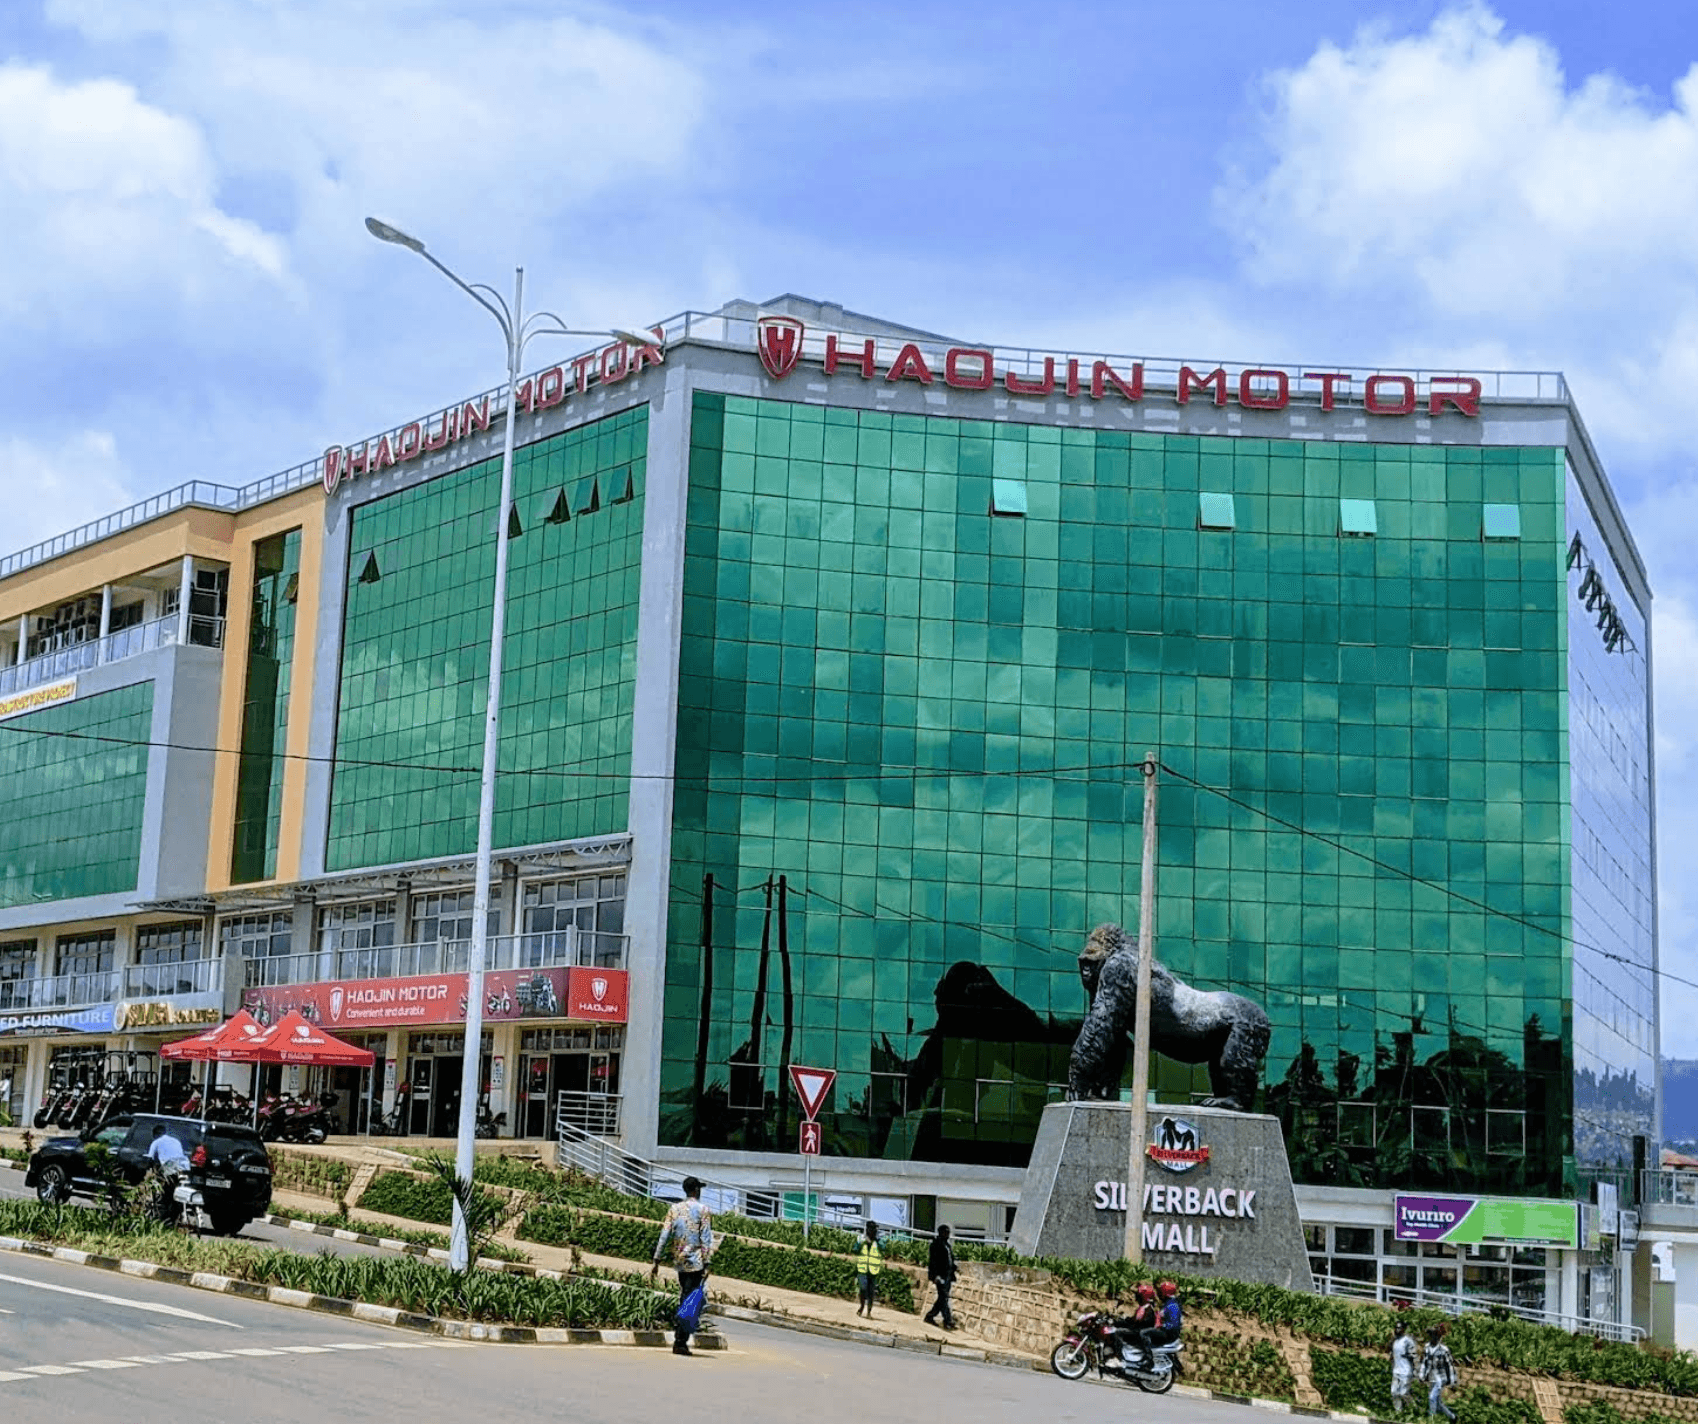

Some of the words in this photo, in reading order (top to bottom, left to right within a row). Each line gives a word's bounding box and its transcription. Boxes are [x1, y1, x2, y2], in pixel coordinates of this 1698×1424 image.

[823, 334, 1144, 400] HAOJIN
[1176, 365, 1482, 416] MOTOR
[345, 396, 491, 479] HAOJIN
[346, 988, 395, 1003] HAOJIN
[398, 984, 448, 1000] MOTOR
[346, 1007, 384, 1019] Convenient
[384, 1005, 398, 1016] and
[398, 1005, 426, 1016] durable
[578, 1003, 619, 1012] HAOJIN
[22, 1010, 109, 1027] FURNITURE
[1400, 1205, 1456, 1223] Ivuriro
[1141, 1222, 1214, 1254] MALL
